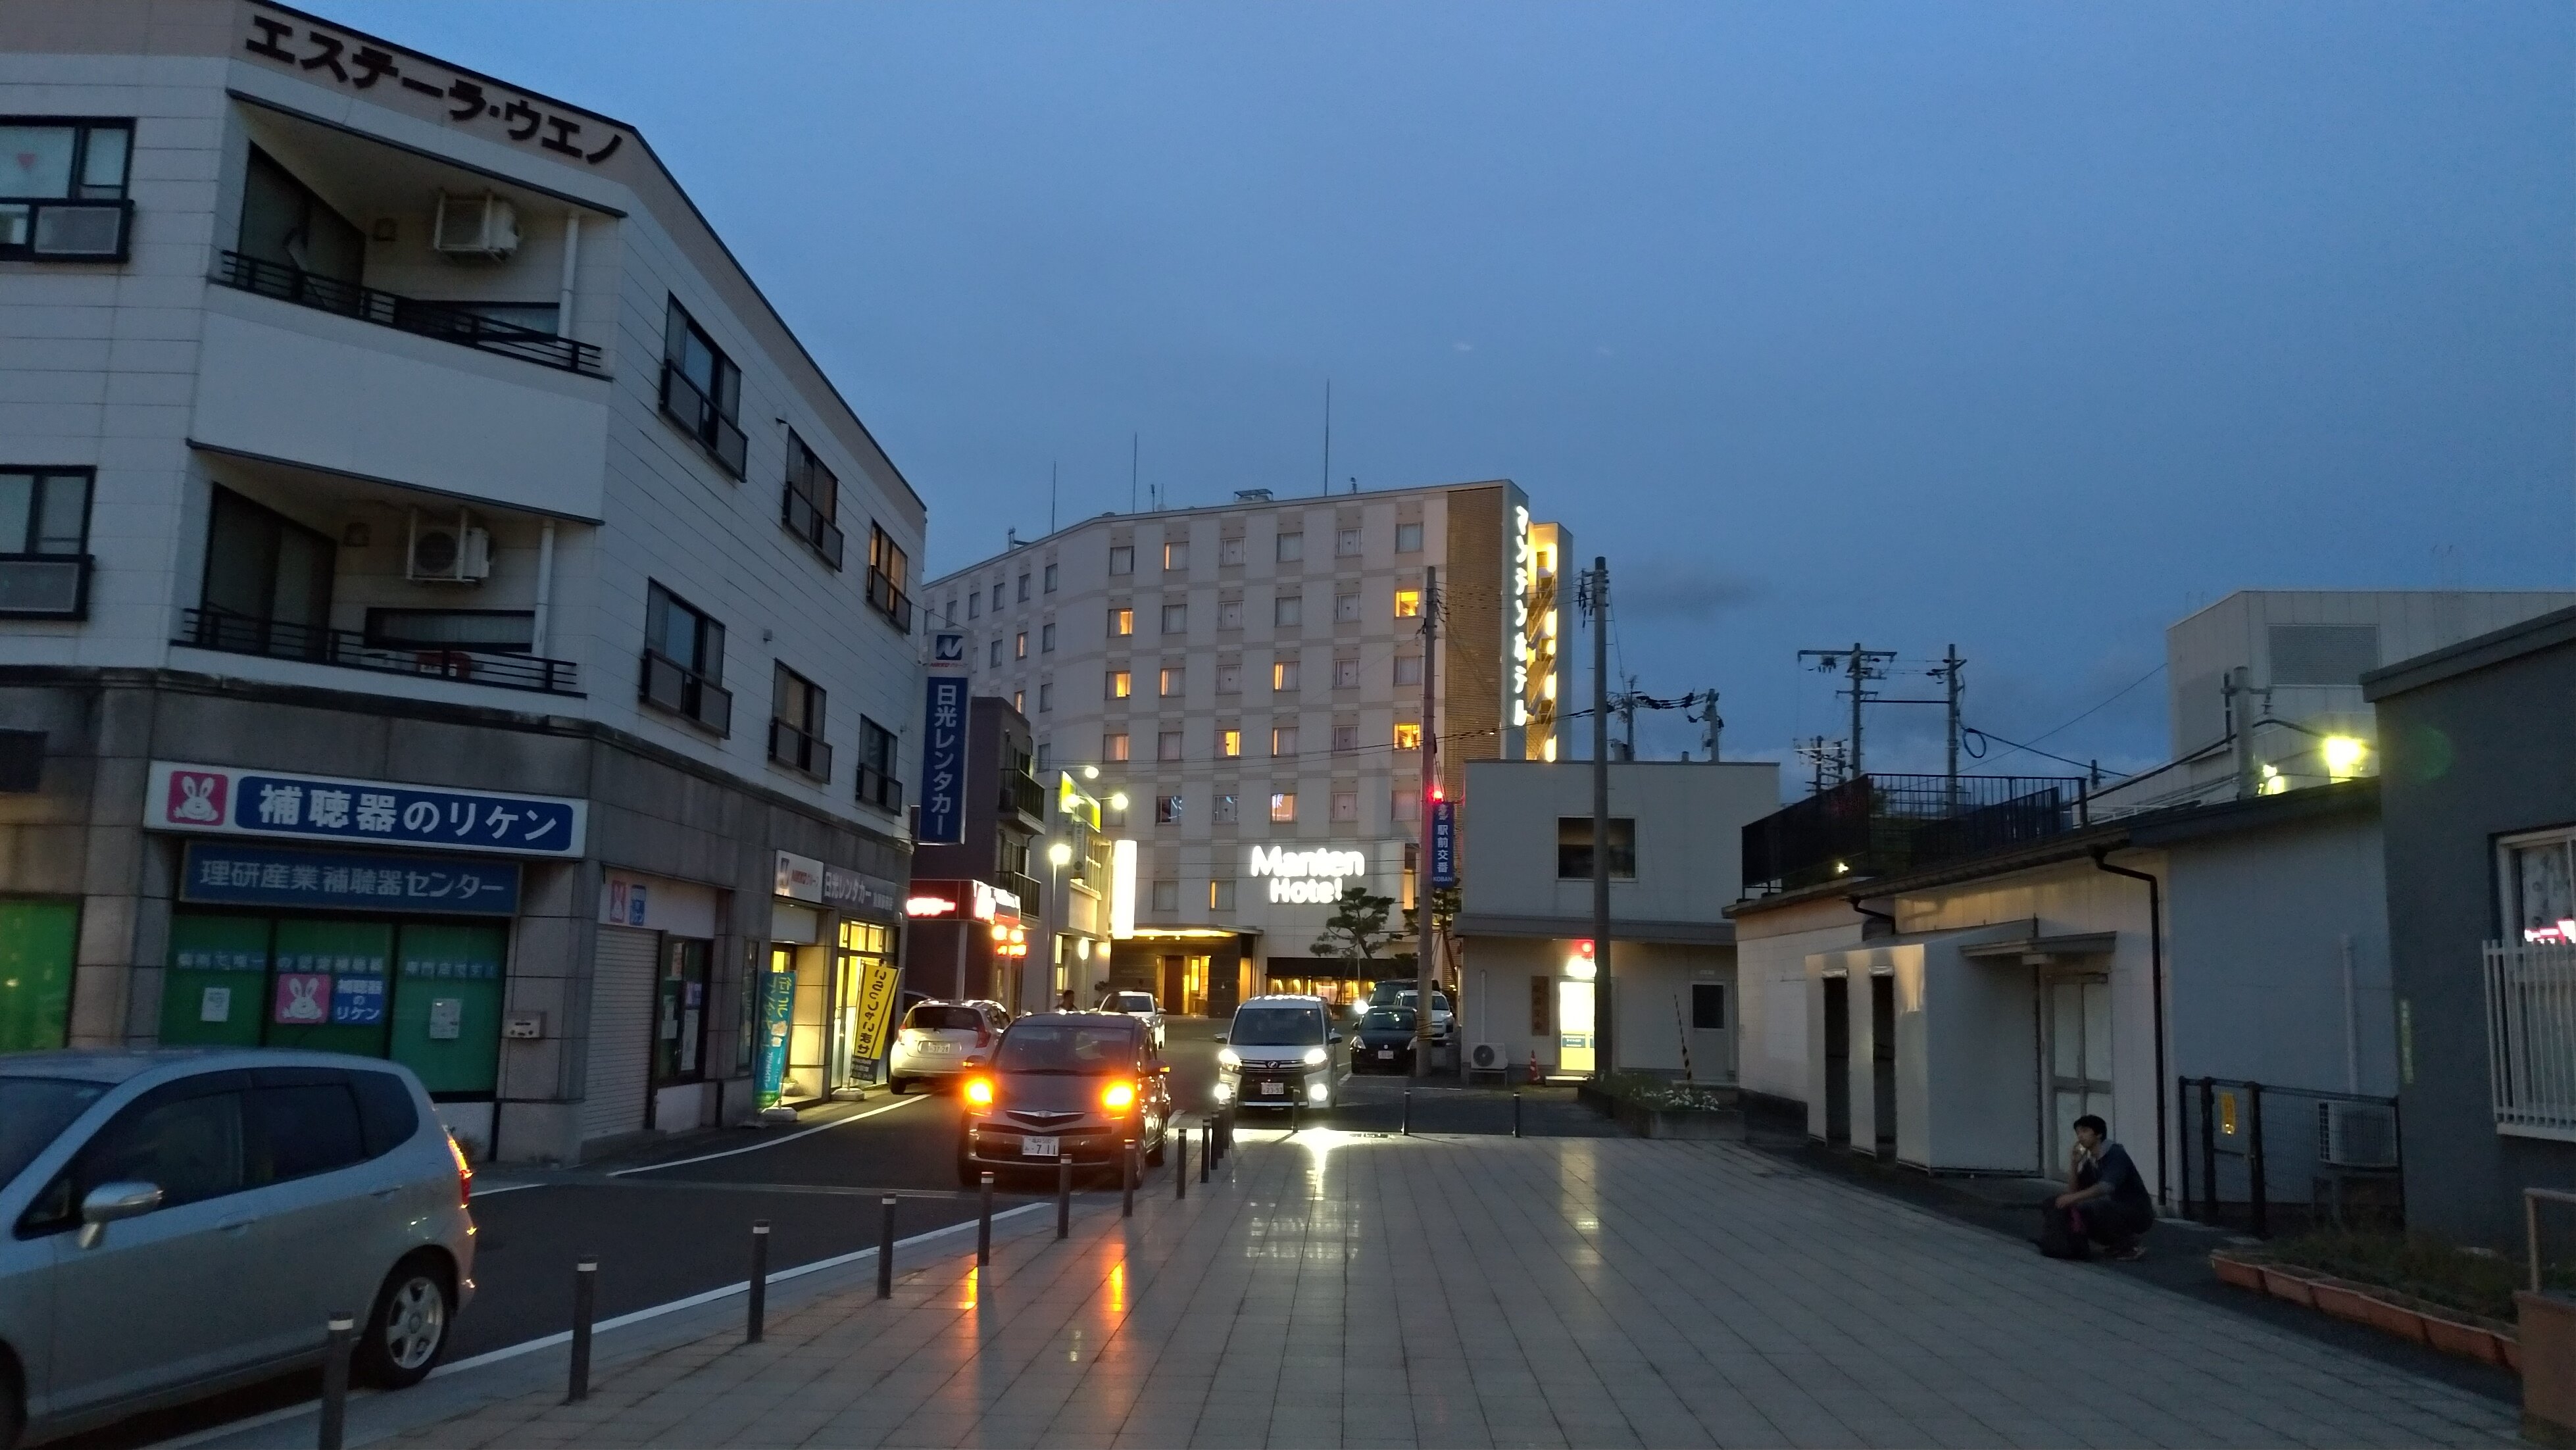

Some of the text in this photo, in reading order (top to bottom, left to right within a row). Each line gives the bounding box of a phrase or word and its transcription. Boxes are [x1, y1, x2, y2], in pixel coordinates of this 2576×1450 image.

[246, 14, 622, 164] エステーラ・ウエノ
[931, 685, 957, 836] 日光レンタカー
[260, 783, 557, 841] 補聴器のリケン
[1251, 845, 1365, 878] Manten
[1437, 824, 1449, 873] 駅前交番
[337, 1007, 381, 1021] リケン
